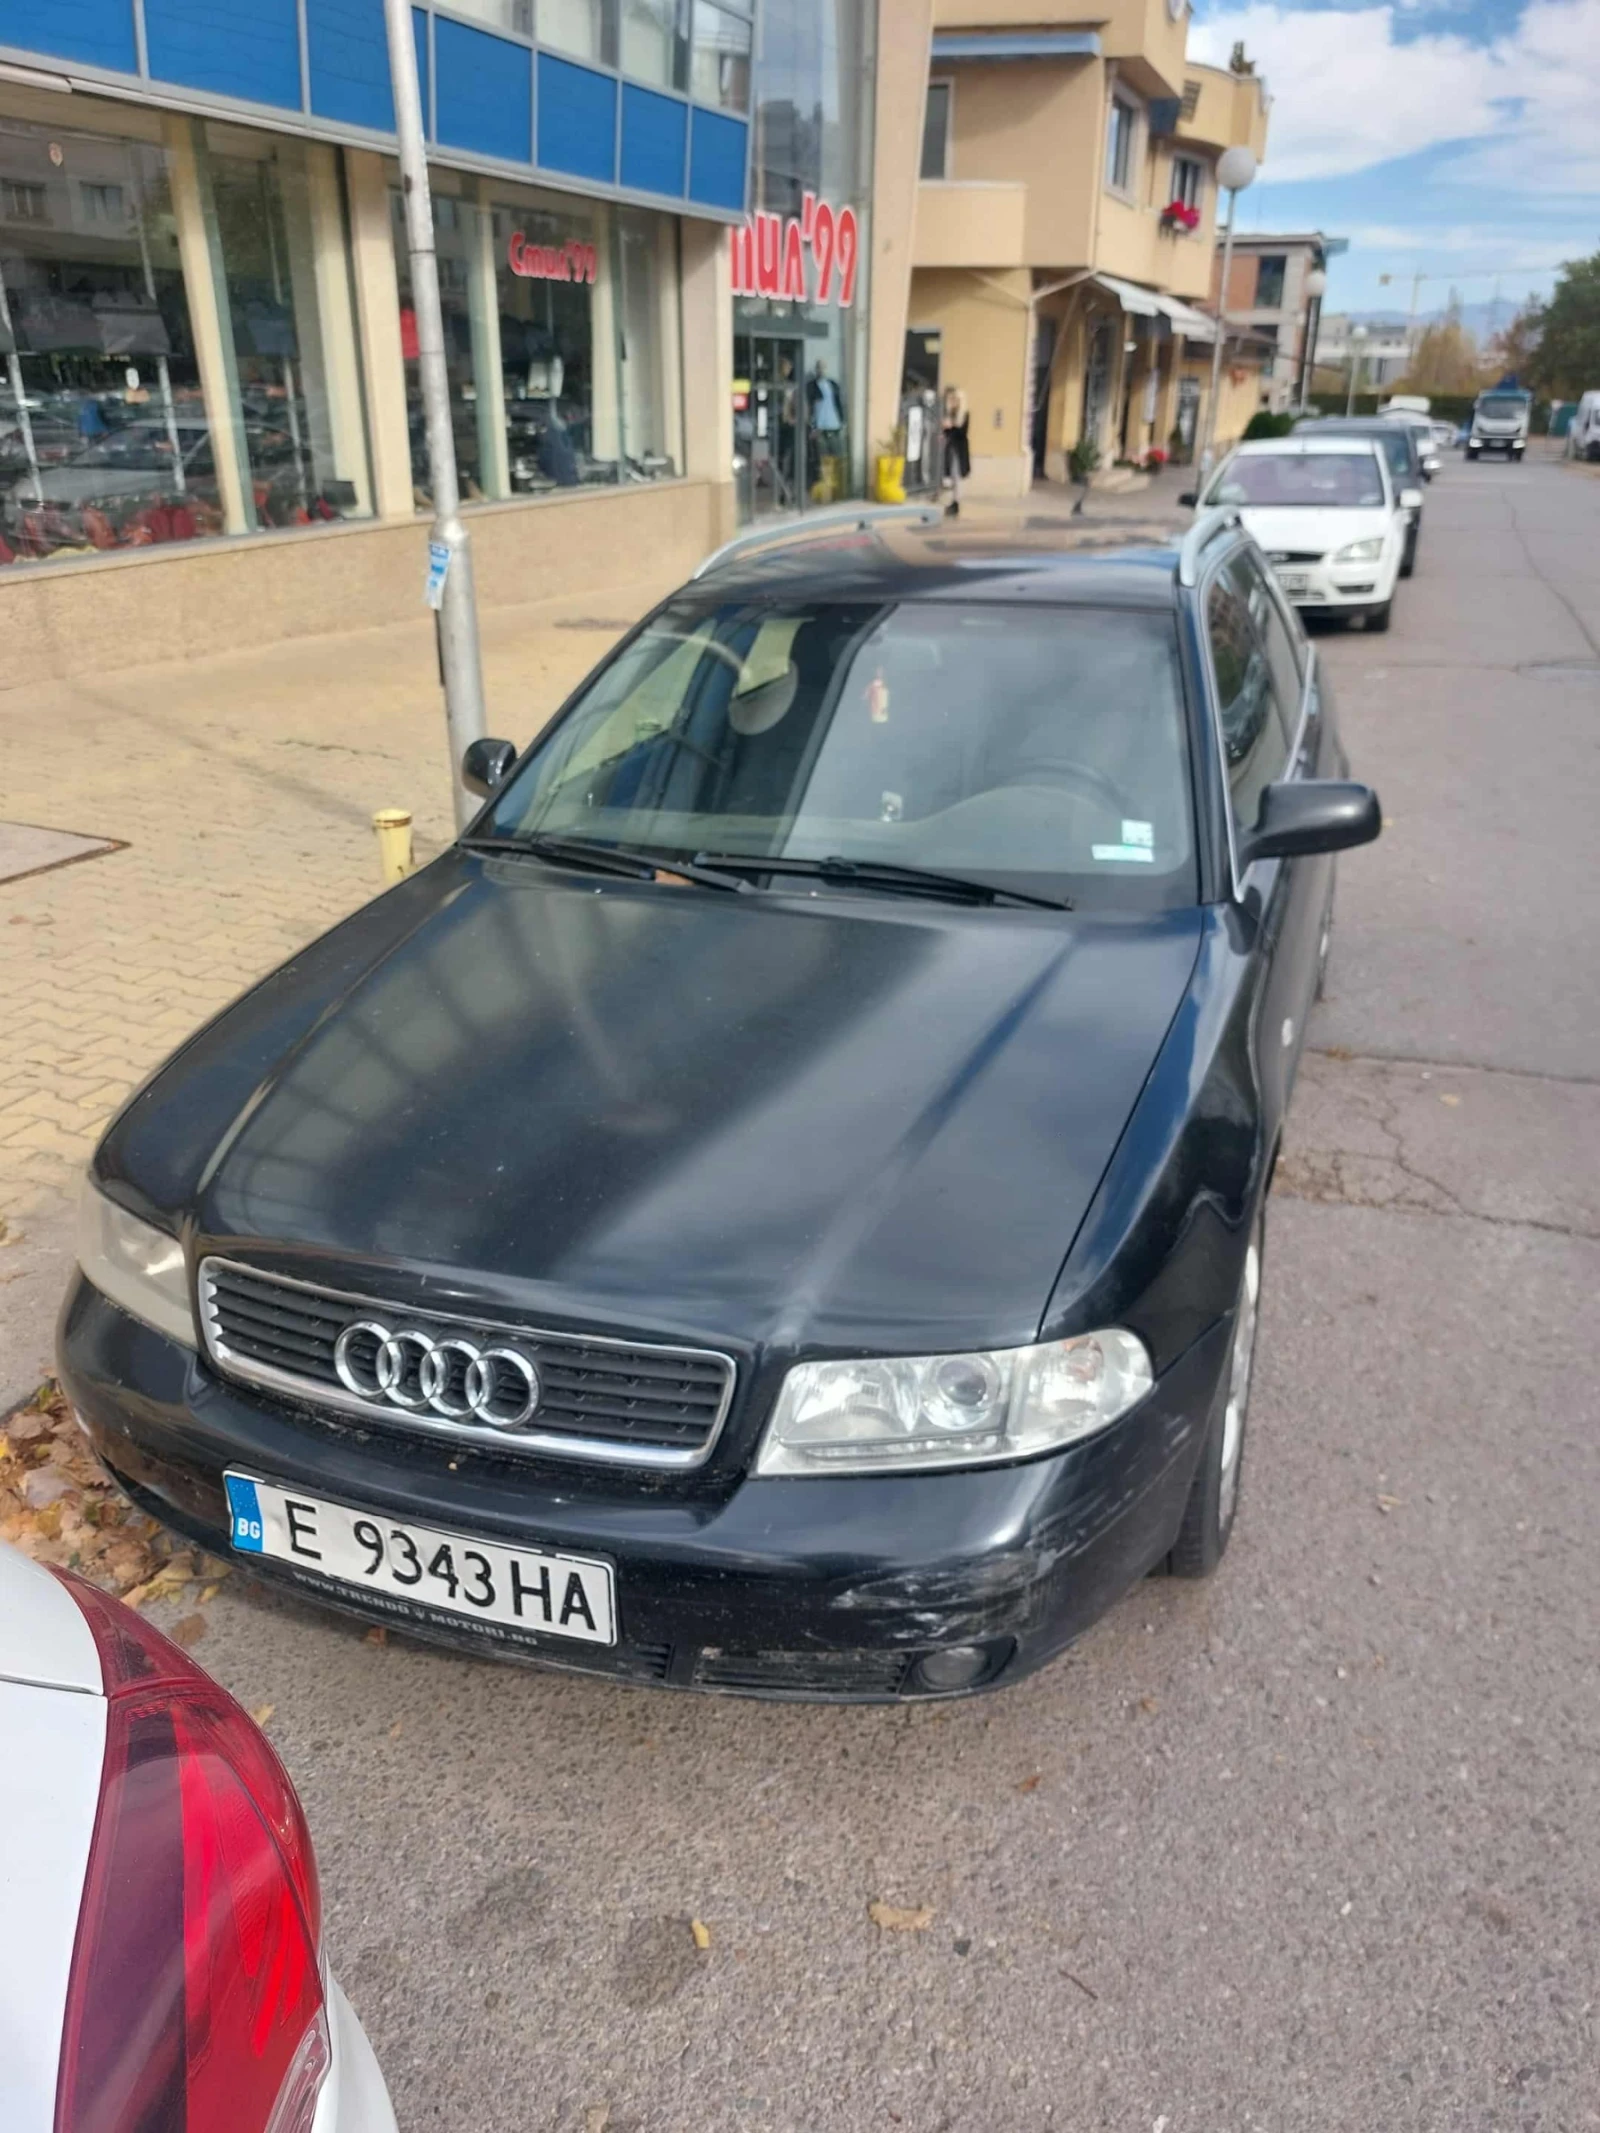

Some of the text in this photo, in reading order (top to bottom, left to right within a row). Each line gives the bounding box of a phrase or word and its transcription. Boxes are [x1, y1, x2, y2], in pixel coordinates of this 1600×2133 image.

[237, 1517, 261, 1540] BG
[285, 1499, 597, 1631] E 9343 HA
